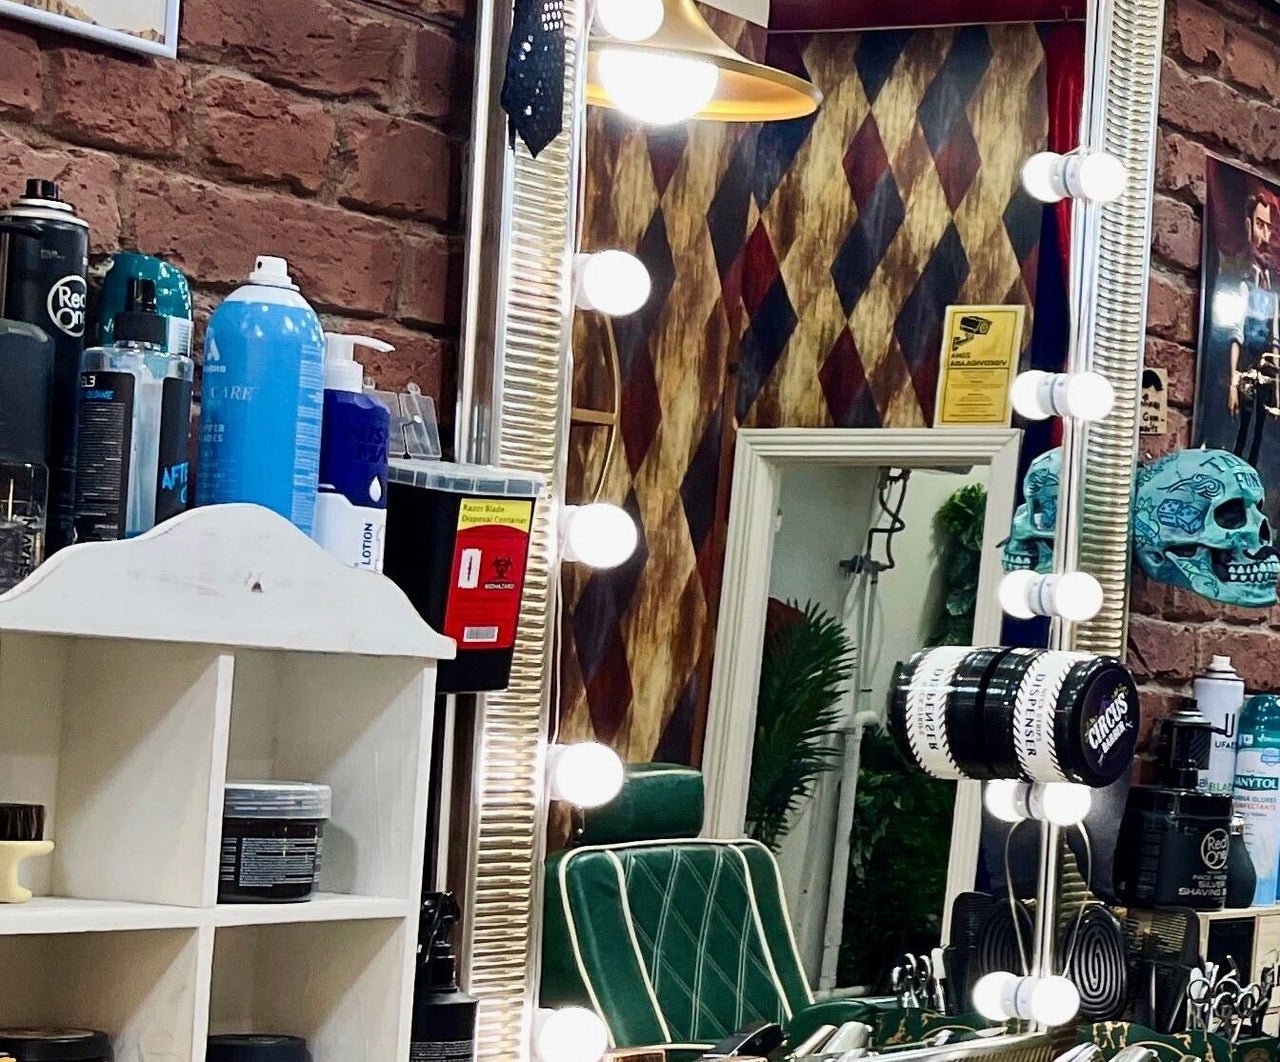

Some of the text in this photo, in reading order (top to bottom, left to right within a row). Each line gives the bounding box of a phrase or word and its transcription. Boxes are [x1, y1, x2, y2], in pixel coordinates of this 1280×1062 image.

[461, 514, 528, 524] Disposal Container
[463, 503, 505, 513] Razor Blade
[362, 522, 373, 566] LOTION
[1025, 673, 1046, 756] DISPENSER
[1088, 692, 1129, 750] CIRCUS
[1207, 836, 1227, 851] Red
